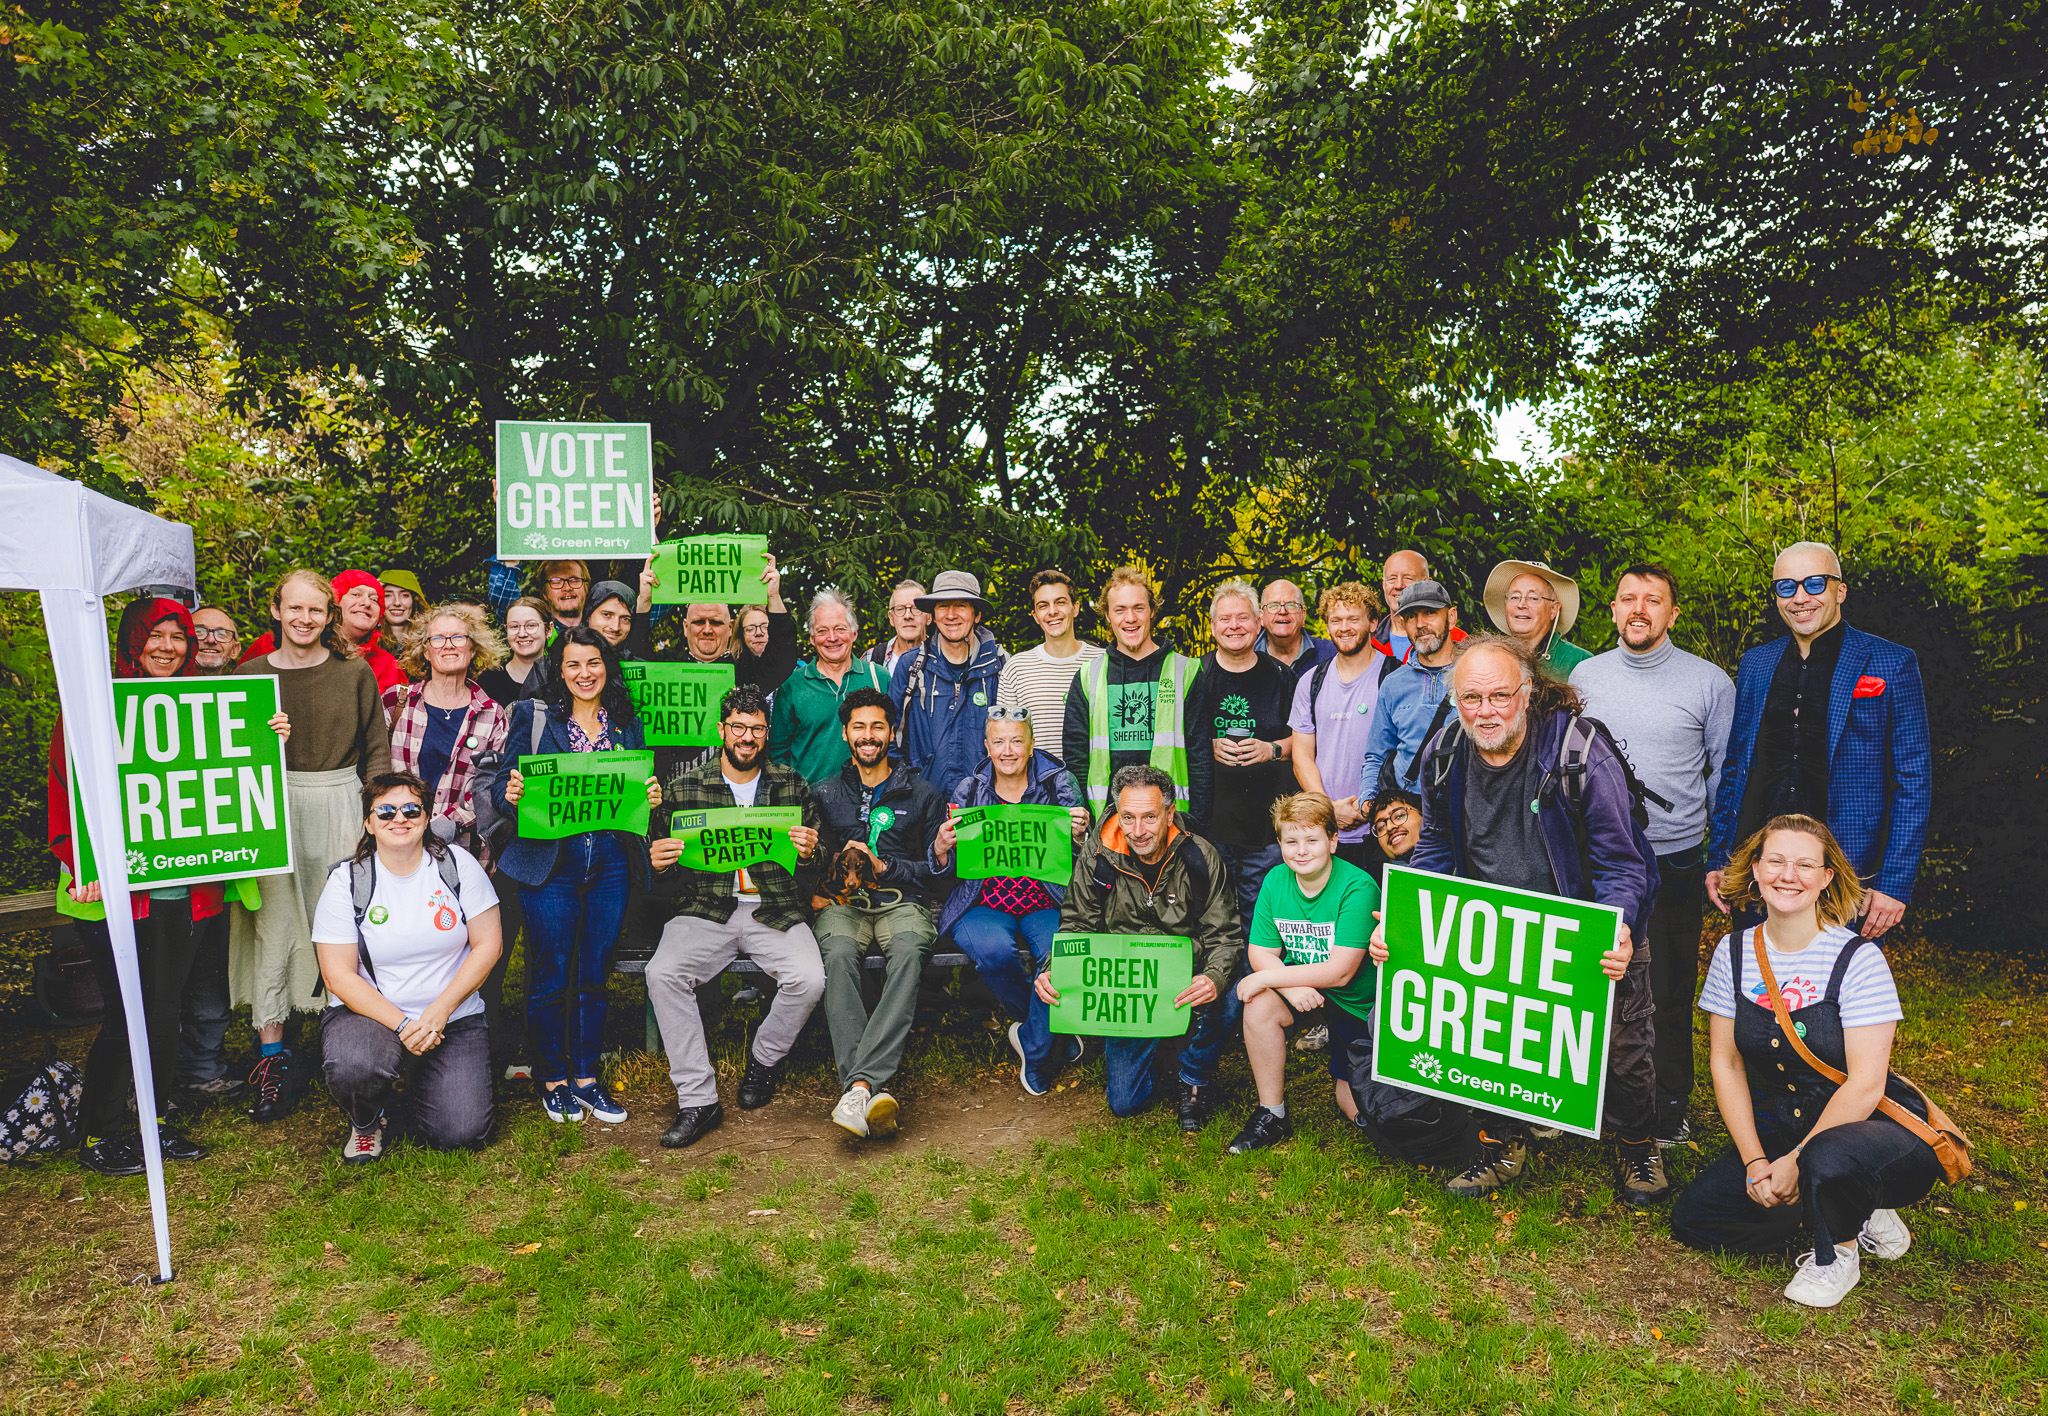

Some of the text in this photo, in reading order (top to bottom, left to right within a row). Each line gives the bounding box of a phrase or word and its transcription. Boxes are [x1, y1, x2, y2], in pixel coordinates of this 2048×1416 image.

[521, 431, 627, 478] VOTE
[506, 482, 644, 529] GREEN
[551, 536, 630, 550] Green Party
[676, 543, 742, 566] GREEN
[677, 569, 742, 594] PARTY
[640, 682, 707, 707] GREEN
[115, 691, 251, 764] VOTE
[640, 710, 707, 735] PARTY
[1214, 716, 1256, 728] Green
[1113, 730, 1155, 742] SHEFFIELD
[530, 762, 554, 775] VOTE
[549, 773, 626, 798] GREEN
[125, 765, 277, 843] REEN
[549, 799, 623, 828] PARTY
[680, 815, 703, 828] VOTE
[962, 812, 982, 825] VOTE
[700, 826, 773, 847] GREEN
[981, 820, 1047, 844] GREEN
[153, 847, 259, 869] Green Party
[703, 842, 773, 866] PARTY
[983, 845, 1047, 870] PARTY
[1278, 922, 1331, 937] BEWAR THE
[1418, 888, 1580, 996] VOTE
[1063, 941, 1086, 954] VOTE
[1082, 957, 1158, 989] GREEN
[1792, 976, 1818, 1006] APPL
[1082, 991, 1158, 1024] PARTY
[1390, 969, 1595, 1086] GREEN
[1447, 1067, 1563, 1113] Green Party
